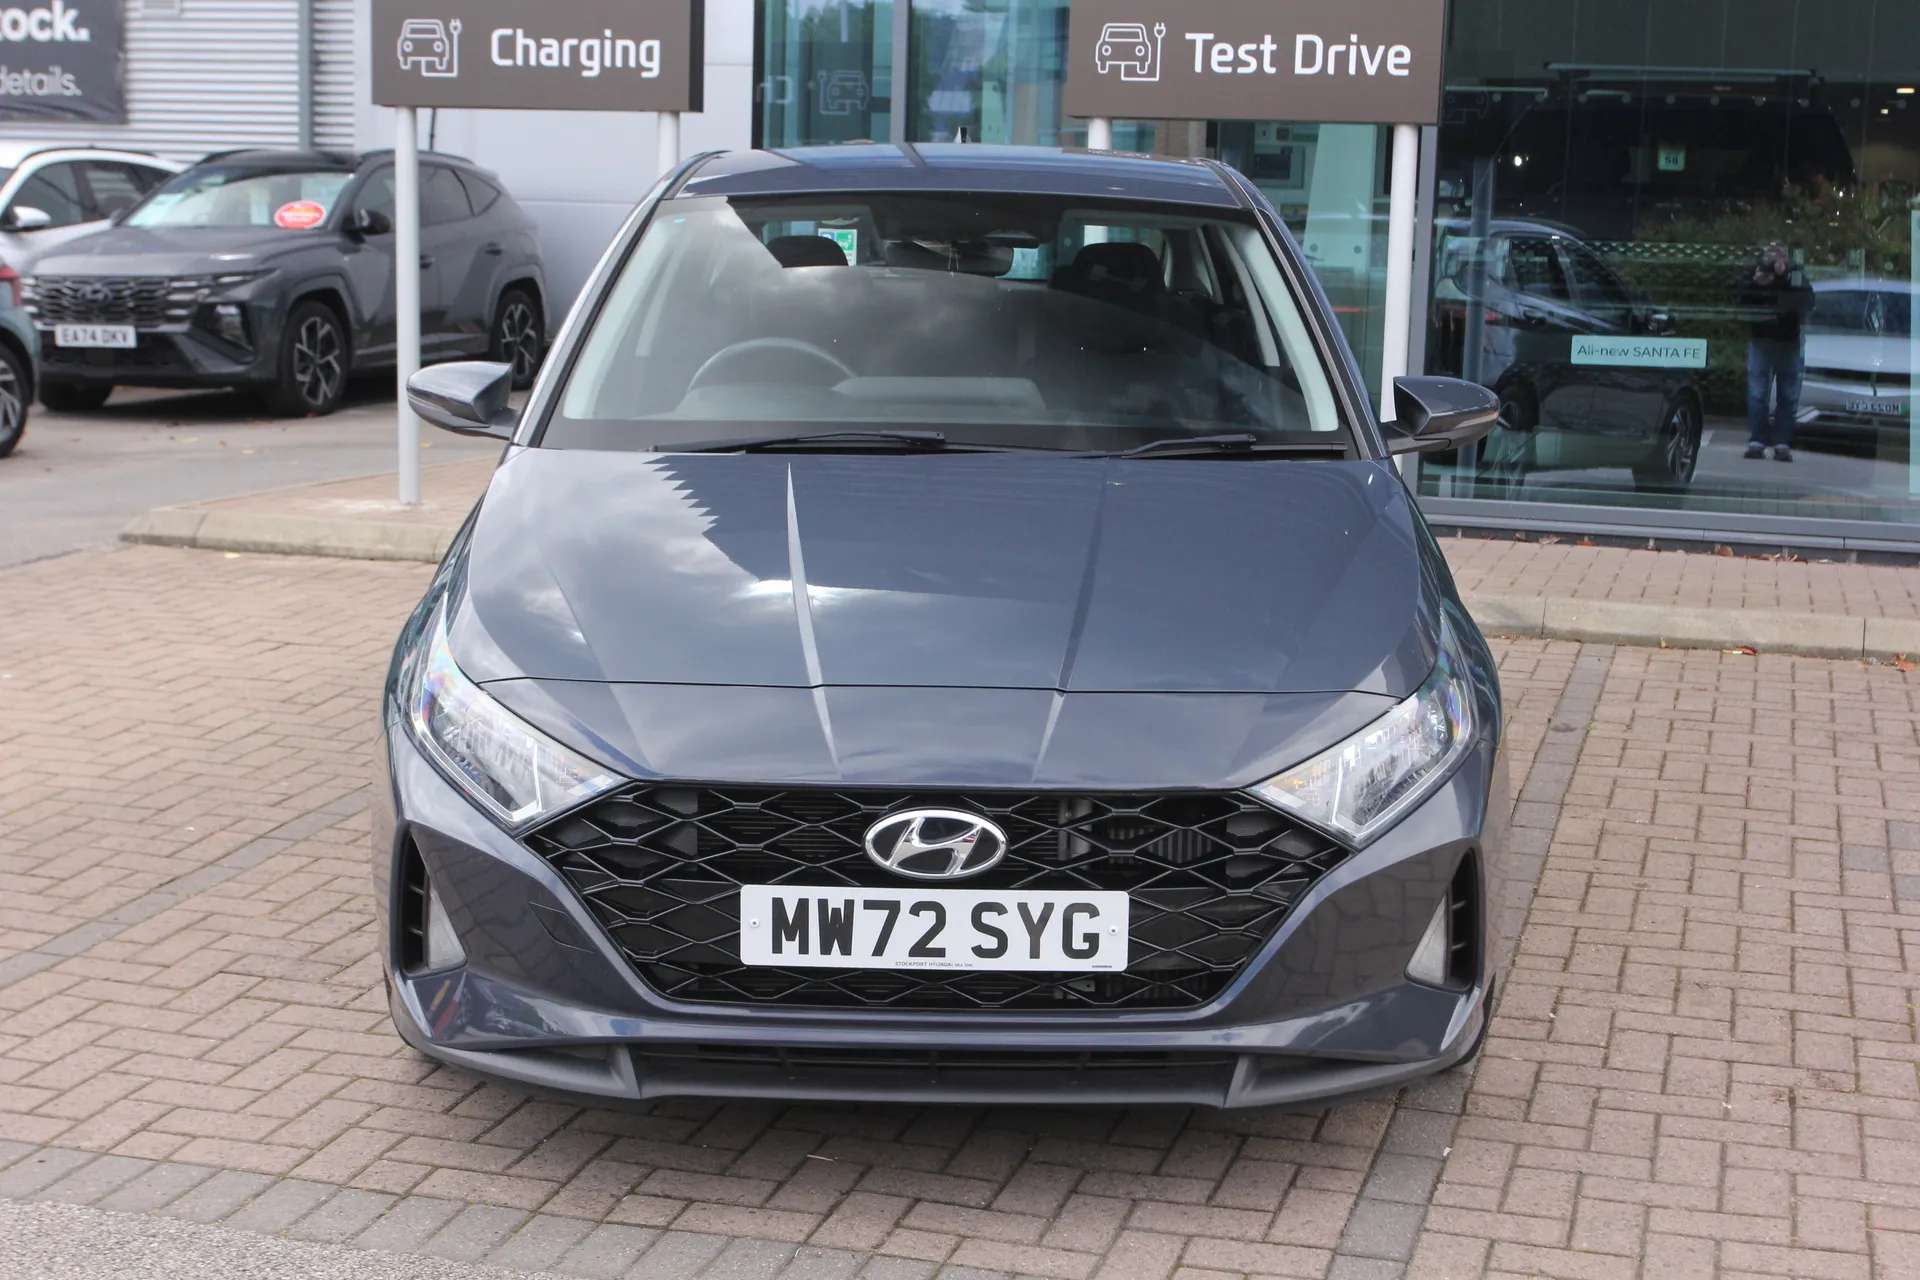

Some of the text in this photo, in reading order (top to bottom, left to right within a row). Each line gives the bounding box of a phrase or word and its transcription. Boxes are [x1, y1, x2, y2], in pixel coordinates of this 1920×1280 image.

[0, 0, 91, 42] ock.
[491, 28, 661, 78] Charging
[1185, 33, 1411, 76] Test Drive
[1577, 344, 1701, 360] All-new SANTA FE
[772, 897, 1100, 960] MW72 SYG
